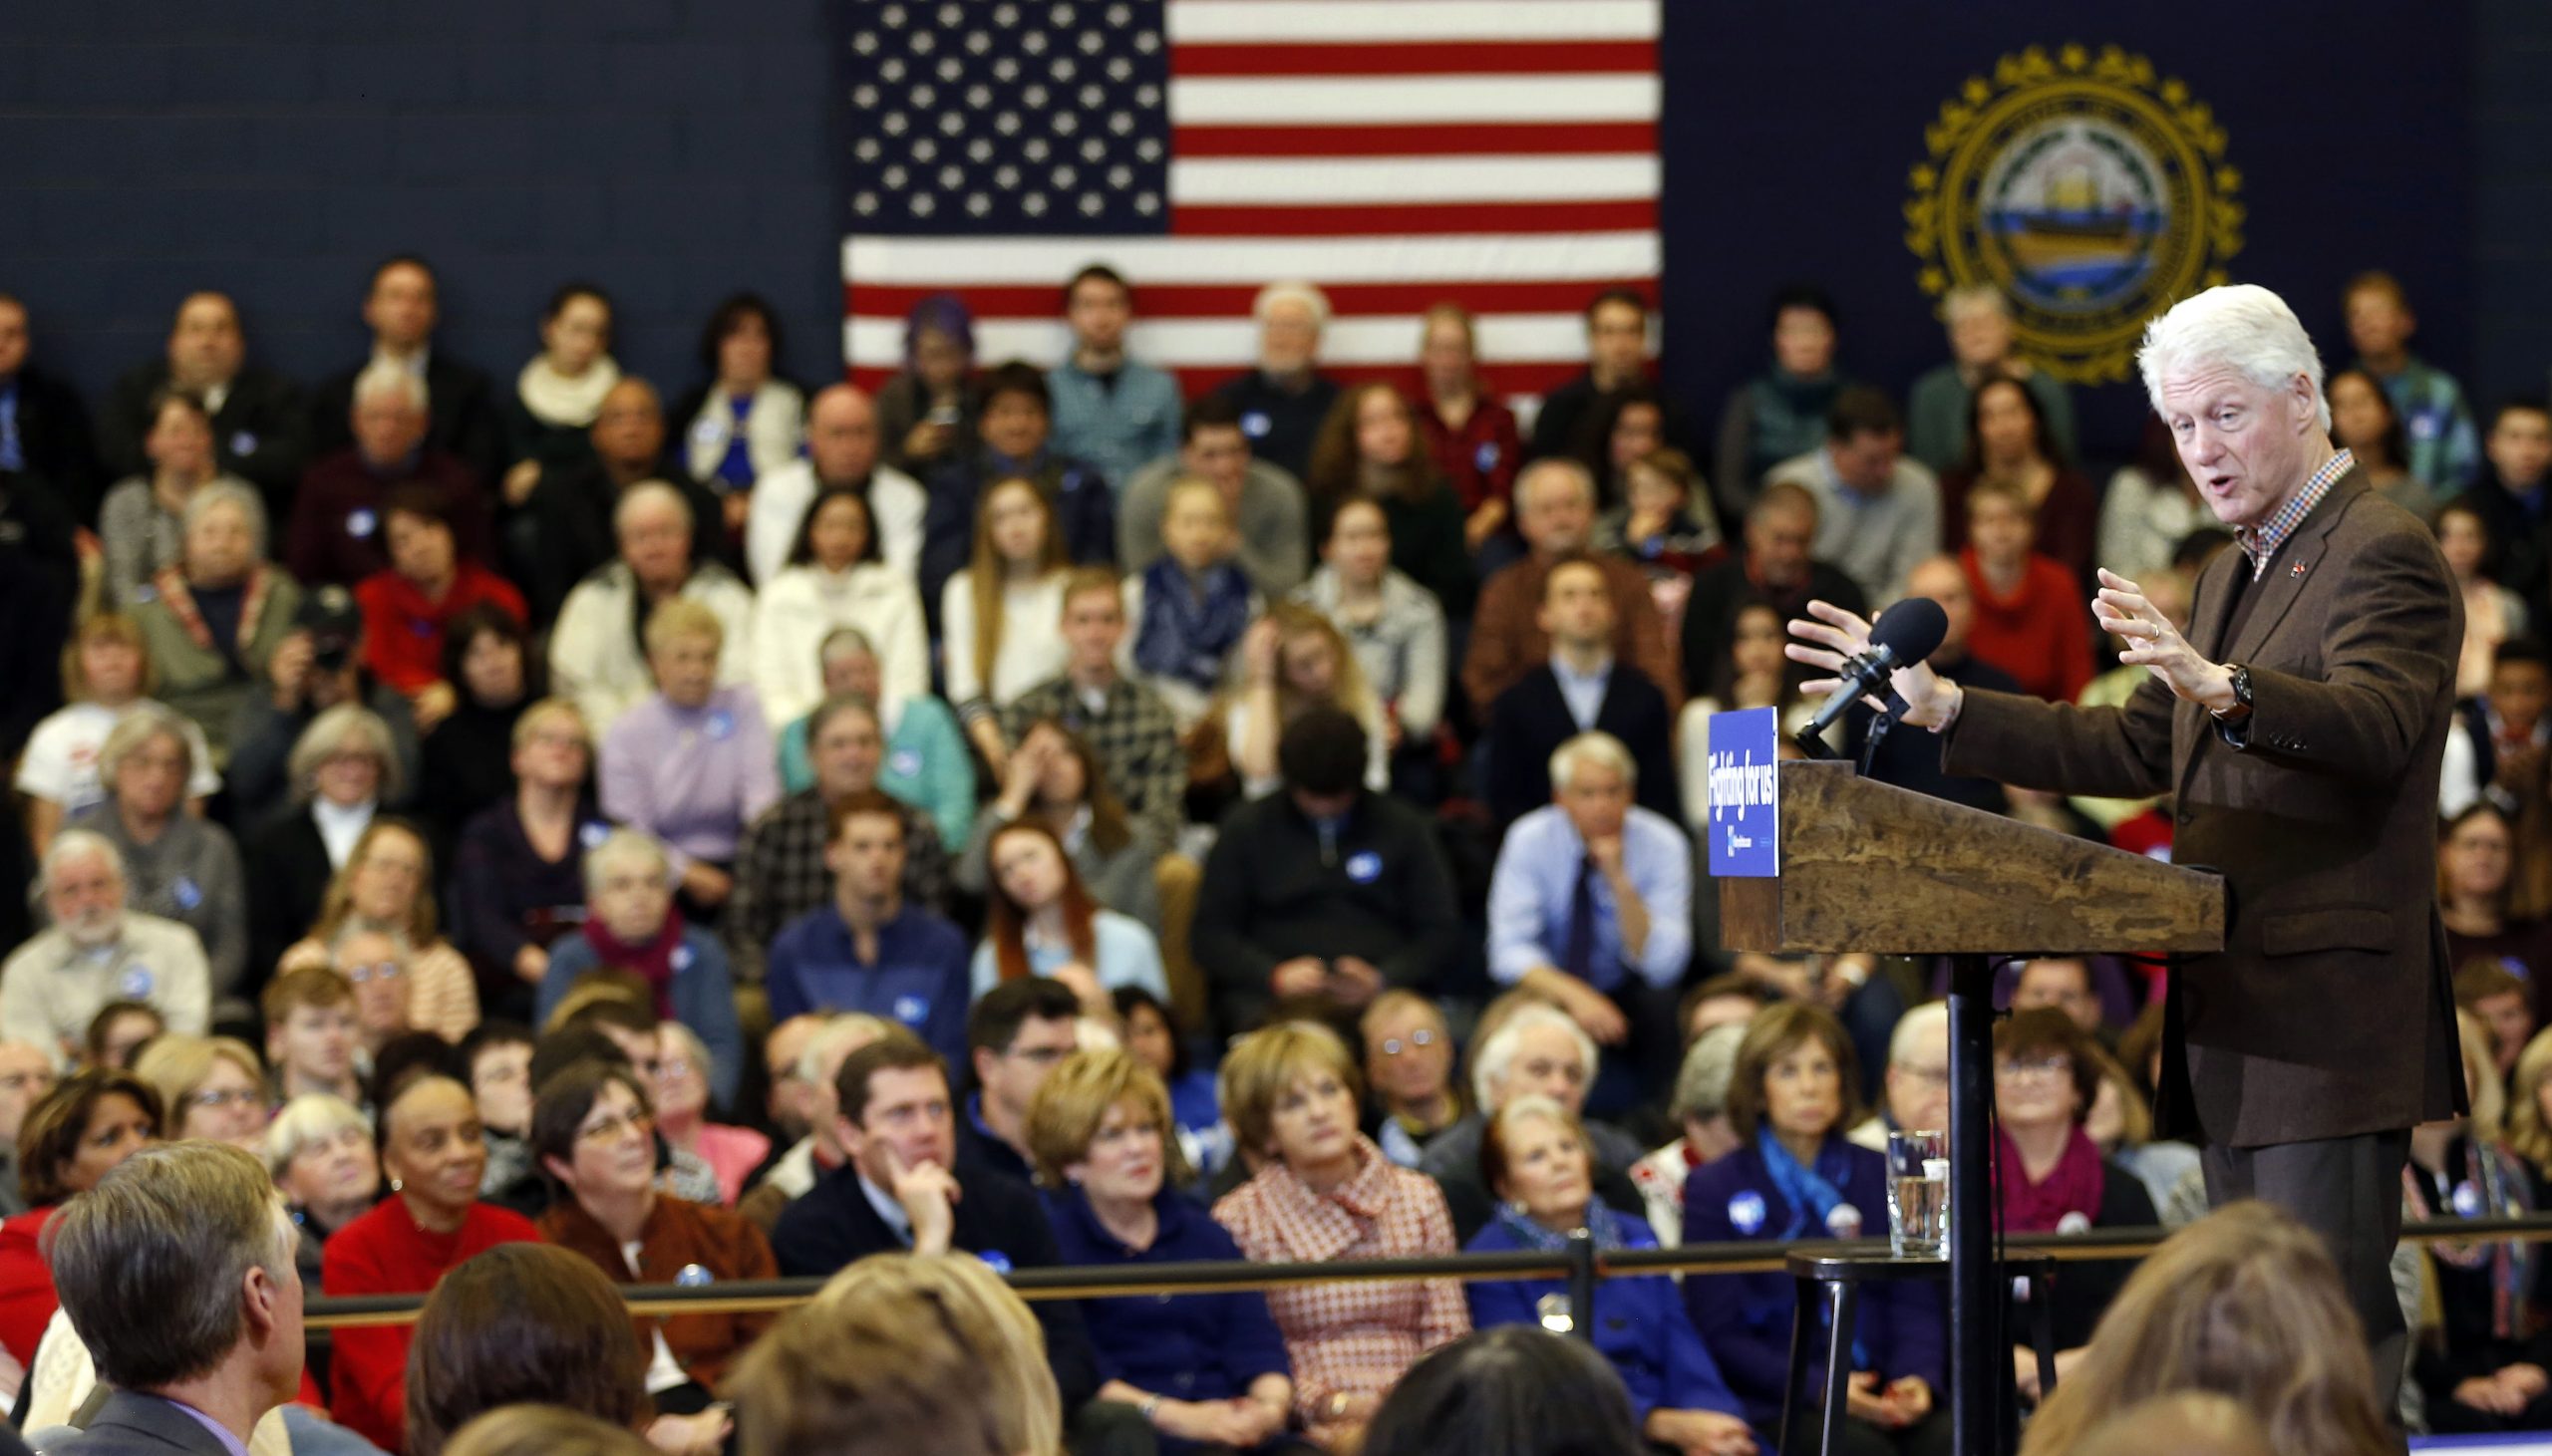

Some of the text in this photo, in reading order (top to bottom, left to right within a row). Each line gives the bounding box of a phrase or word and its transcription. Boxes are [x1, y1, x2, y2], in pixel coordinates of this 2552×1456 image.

[1709, 749, 1773, 822] Fighting for us
